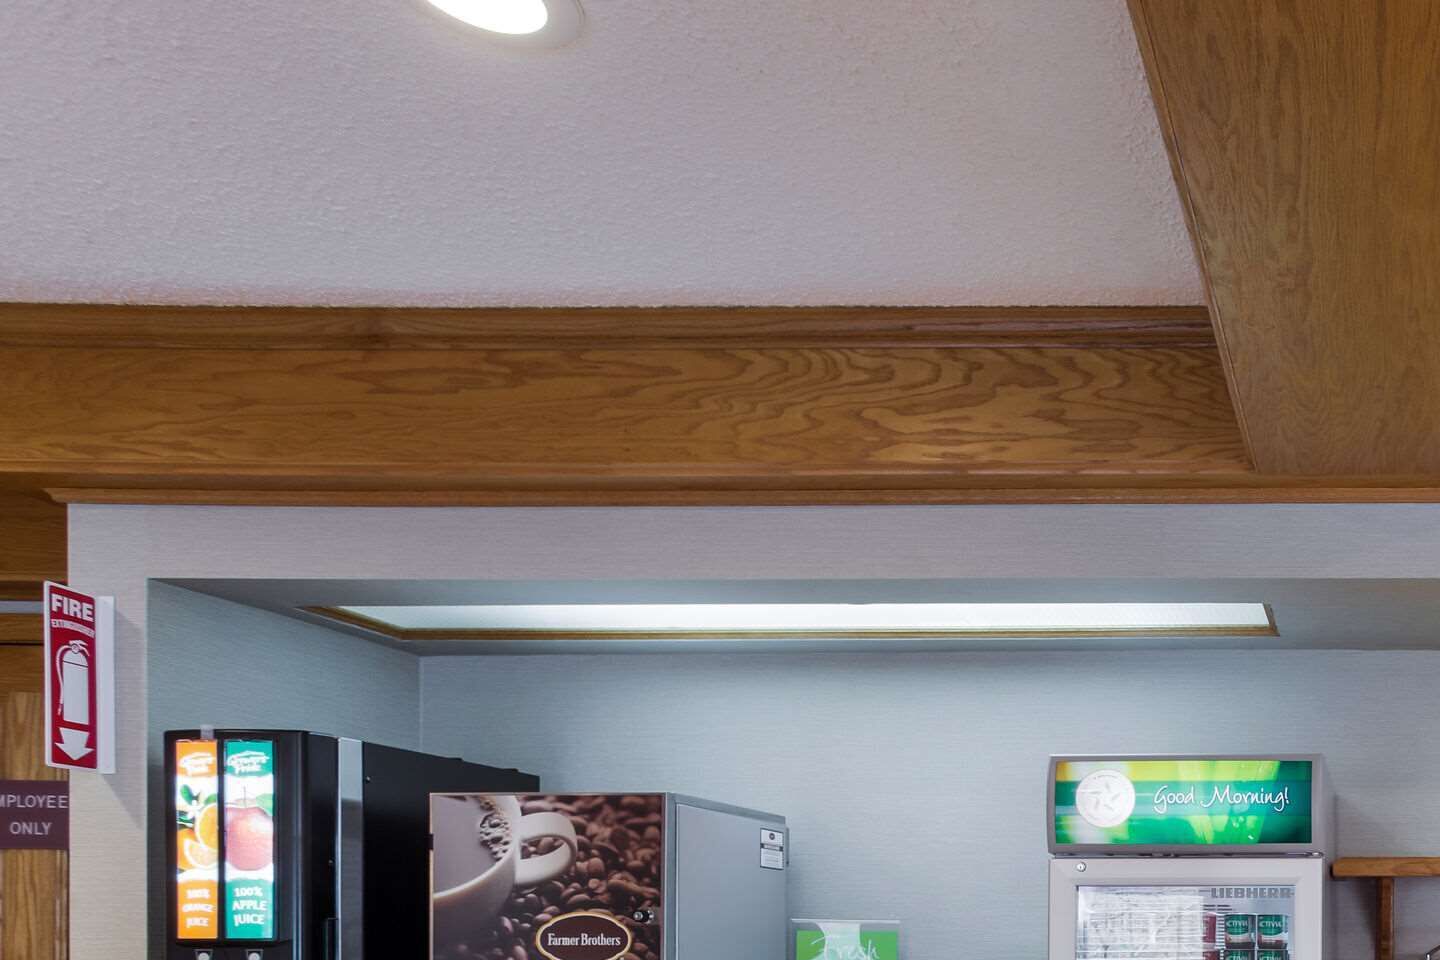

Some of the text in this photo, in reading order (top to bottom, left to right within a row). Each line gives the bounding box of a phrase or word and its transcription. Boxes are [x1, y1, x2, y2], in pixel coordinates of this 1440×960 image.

[51, 593, 94, 622] FIRE
[1153, 785, 1290, 814] Good Morning!
[10, 821, 53, 835] ONLY
[233, 886, 263, 898] 100%
[1211, 887, 1293, 899] LIEBHERR
[232, 900, 268, 911] APPLE
[234, 914, 265, 927] JUICE
[547, 932, 621, 946] Farmer Brothers
[811, 935, 880, 960] Fresh
